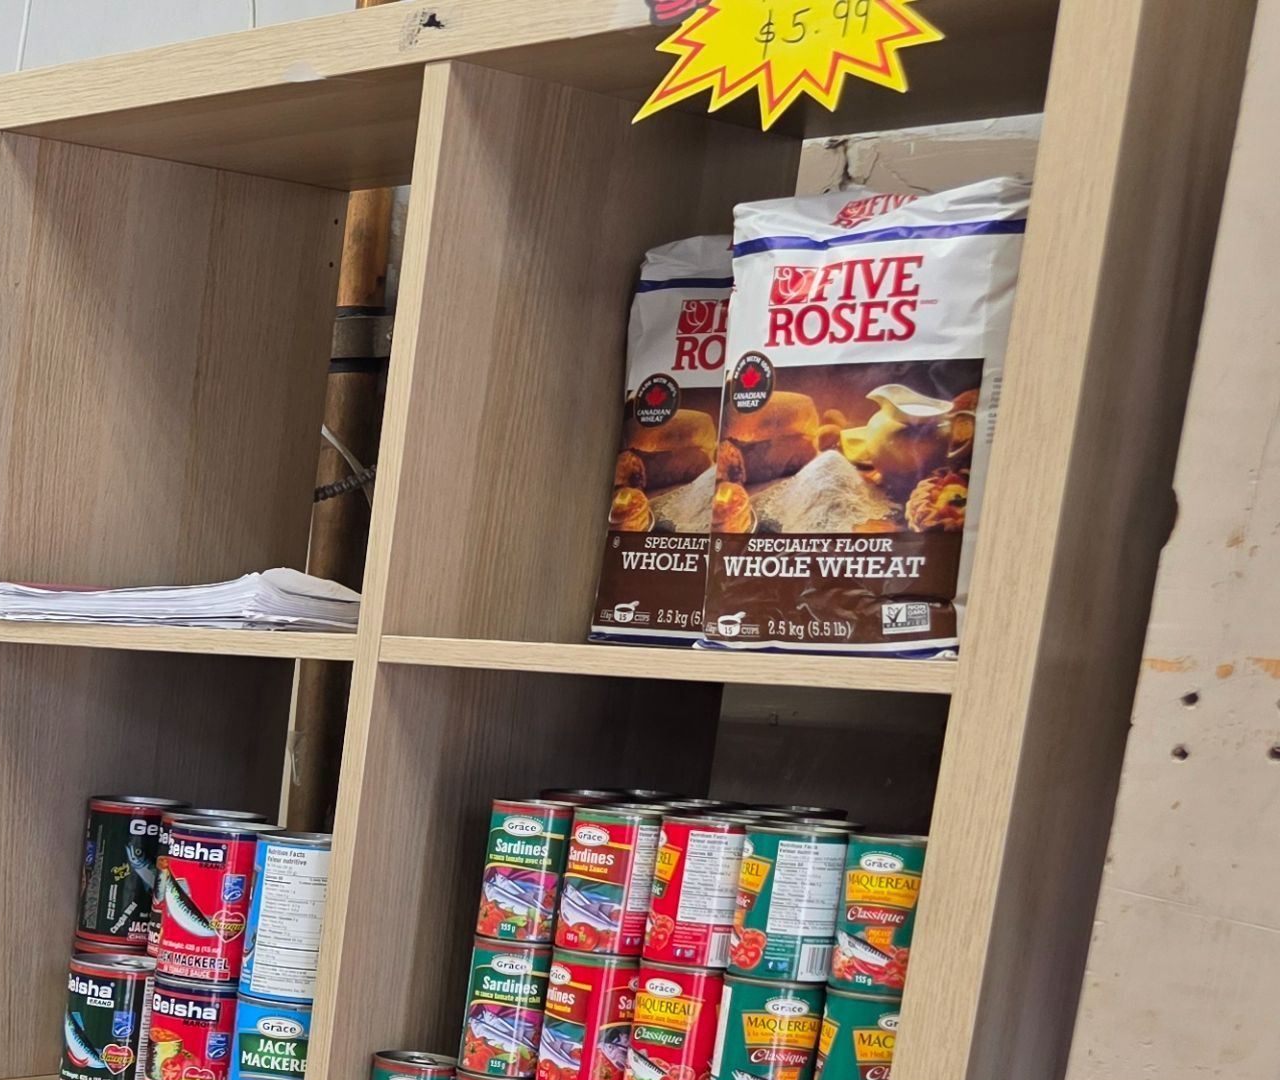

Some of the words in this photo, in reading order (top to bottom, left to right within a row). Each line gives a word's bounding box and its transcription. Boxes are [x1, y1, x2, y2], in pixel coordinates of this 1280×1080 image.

[810, 255, 924, 303] FIVE
[763, 299, 919, 348] ROSES
[732, 390, 767, 401] CANADIAN
[736, 398, 761, 409] WHEAT
[636, 407, 672, 417] CANADIAN
[639, 414, 665, 424] WHEAT
[644, 537, 709, 551] SPECIALT
[747, 538, 832, 553] SPECIALTY
[834, 538, 893, 552] FLOUR
[621, 552, 698, 573] WHOLE
[723, 556, 812, 579] WHOLE
[815, 556, 926, 579] WHEAT
[656, 608, 673, 624] 2.5
[675, 608, 689, 627] kg
[767, 621, 786, 636] 2.5
[788, 620, 805, 640] kg
[807, 621, 831, 639] (5.5
[833, 620, 852, 640] lb)
[507, 821, 537, 833] Grace
[577, 831, 603, 842] Grace
[495, 838, 549, 857] Sardines
[864, 859, 896, 870] Grace
[846, 904, 905, 924] Classique
[174, 952, 229, 970] MACKEREL
[496, 959, 528, 971] Grace
[482, 975, 538, 995] Sardines
[648, 982, 676, 994] Grace
[88, 999, 113, 1007] BRAND
[153, 993, 218, 1020] Geisha
[771, 1003, 804, 1013] Grace
[262, 1021, 297, 1036] Grace
[634, 1026, 683, 1046] Classique
[257, 1037, 298, 1057] JACK
[750, 1048, 808, 1065] Classique
